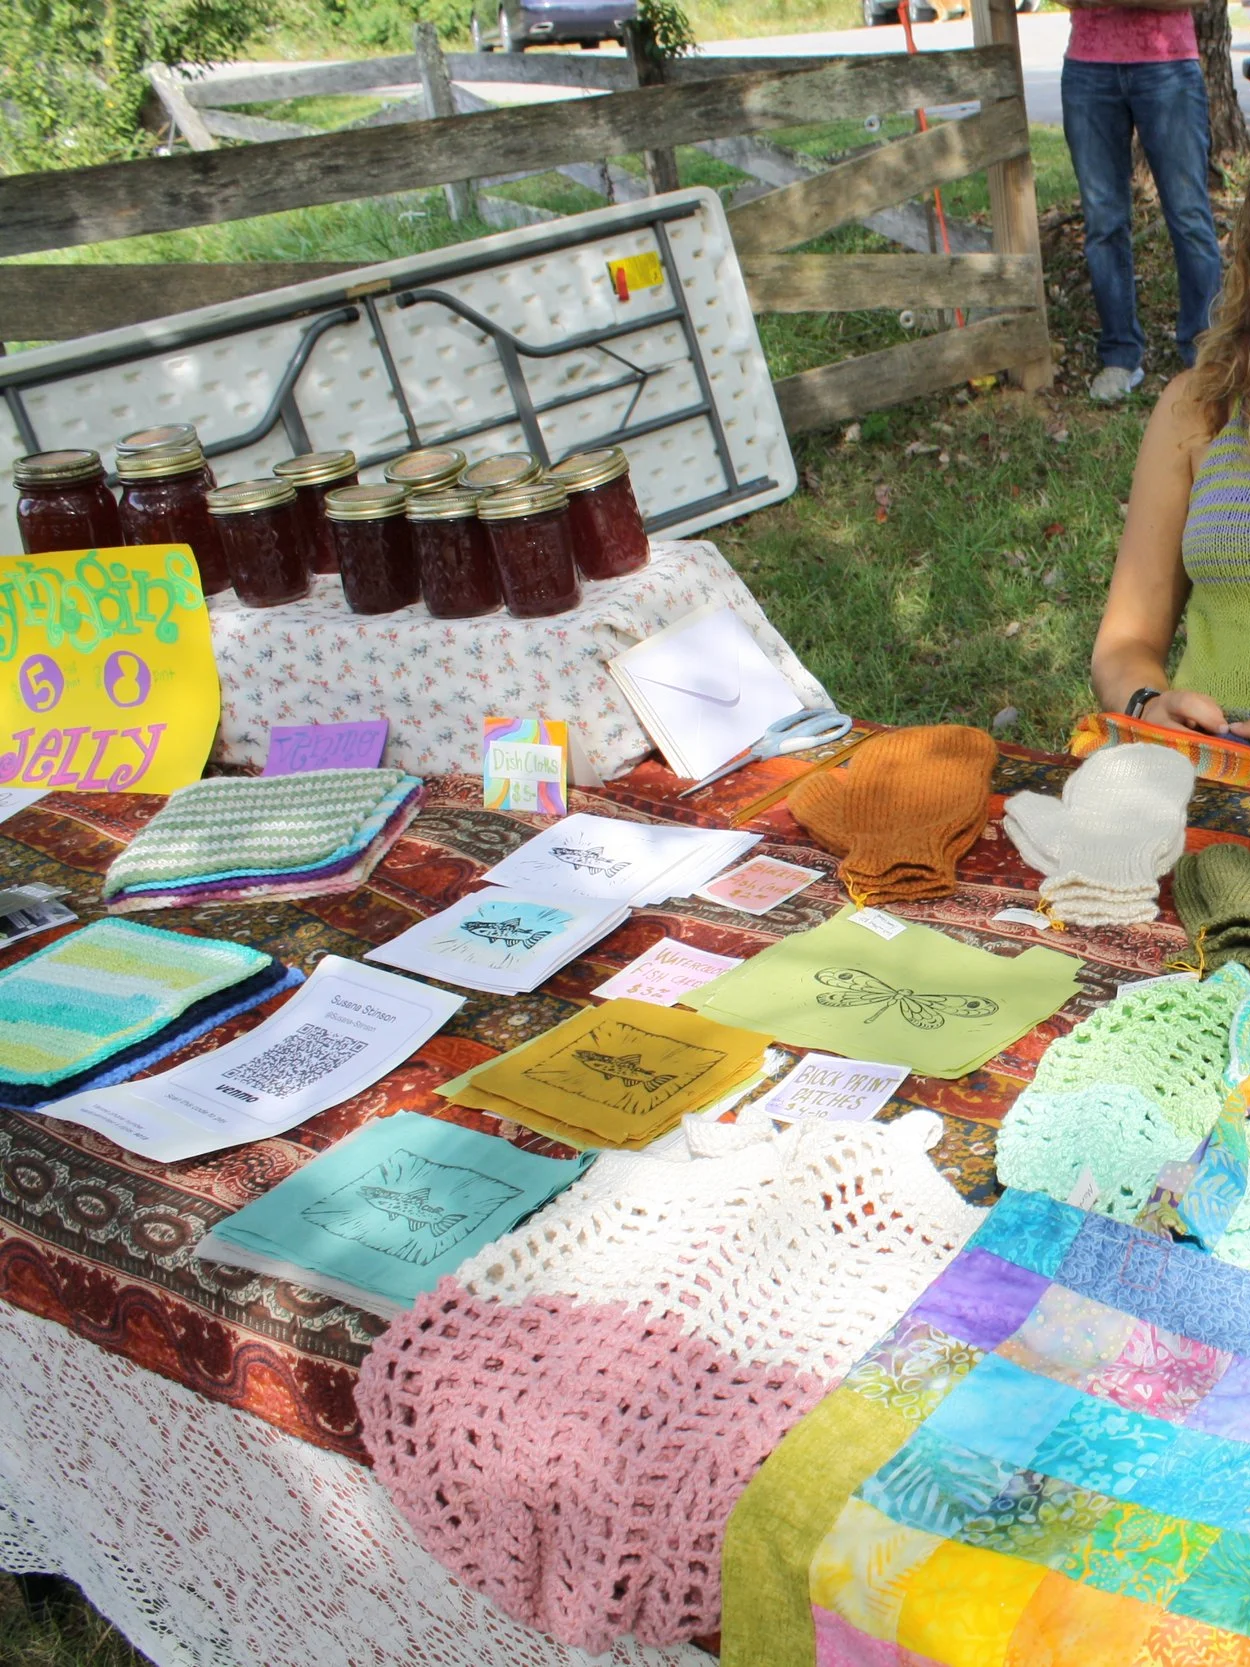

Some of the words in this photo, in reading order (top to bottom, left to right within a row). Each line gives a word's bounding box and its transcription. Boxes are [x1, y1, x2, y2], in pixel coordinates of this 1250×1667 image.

[493, 748, 523, 771] Dish
[331, 995, 362, 1012] Susana
[362, 1005, 397, 1024] Stinson
[215, 1083, 259, 1104] venmo
[844, 1073, 901, 1093] PRINT
[791, 1088, 868, 1111] PATCHES
